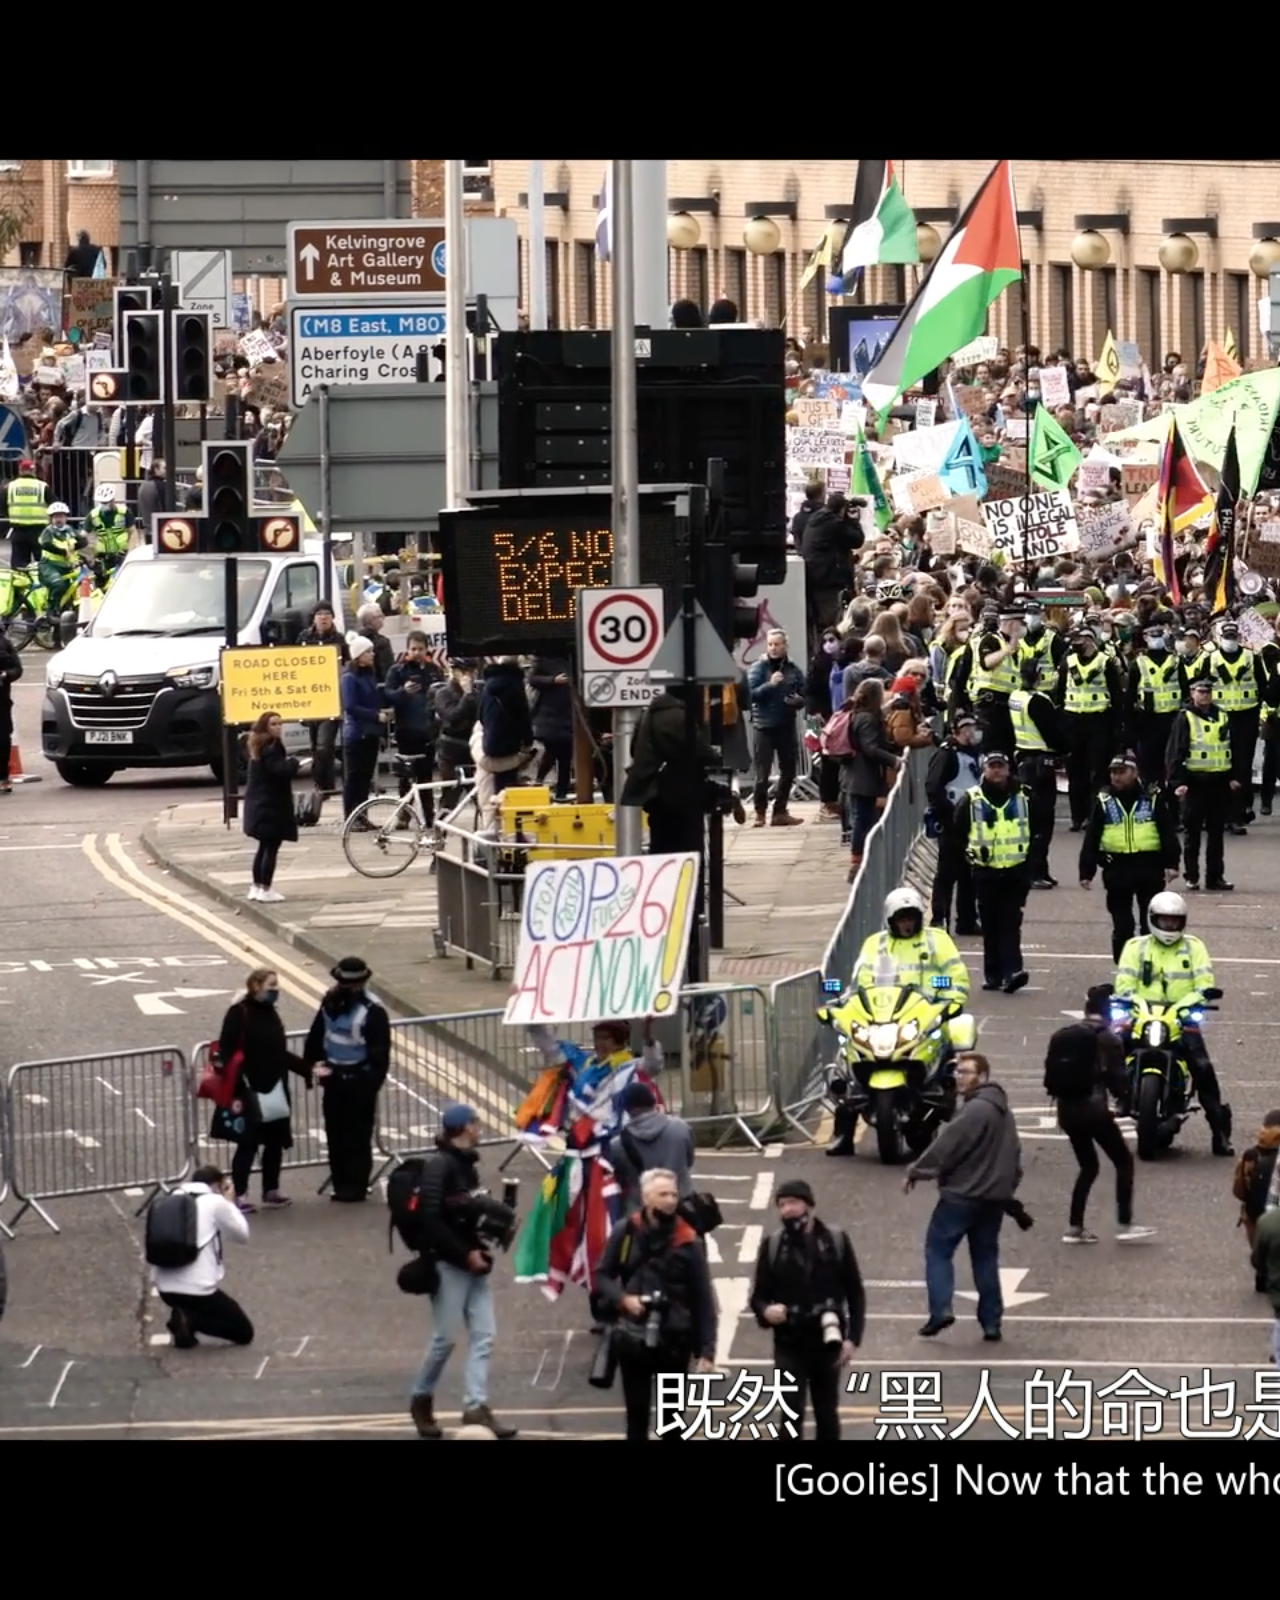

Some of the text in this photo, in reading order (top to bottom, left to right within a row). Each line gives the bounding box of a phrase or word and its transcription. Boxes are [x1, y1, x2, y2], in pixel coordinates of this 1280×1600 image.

[326, 234, 426, 252] Kelvingrove
[327, 252, 425, 269] Art Gallery
[330, 271, 422, 287] & Museum
[303, 316, 447, 336] (M8 East, M80)
[301, 345, 386, 362] Aberfoyle
[301, 364, 418, 381] Charing Cros
[984, 490, 1063, 521] NO ONE
[493, 529, 614, 560] 5/6 NO
[994, 536, 1015, 549] ON
[1010, 539, 1060, 561] LAND
[500, 560, 612, 590] EXPEC
[600, 615, 646, 643] 30
[233, 655, 327, 669] ROAD CLOSED
[262, 671, 298, 682] HERE
[626, 675, 649, 686] Zon
[231, 683, 331, 697] Fri 5th & Sat 6th
[620, 688, 662, 700] ENDS
[251, 698, 312, 711] November
[527, 858, 677, 941] COP26
